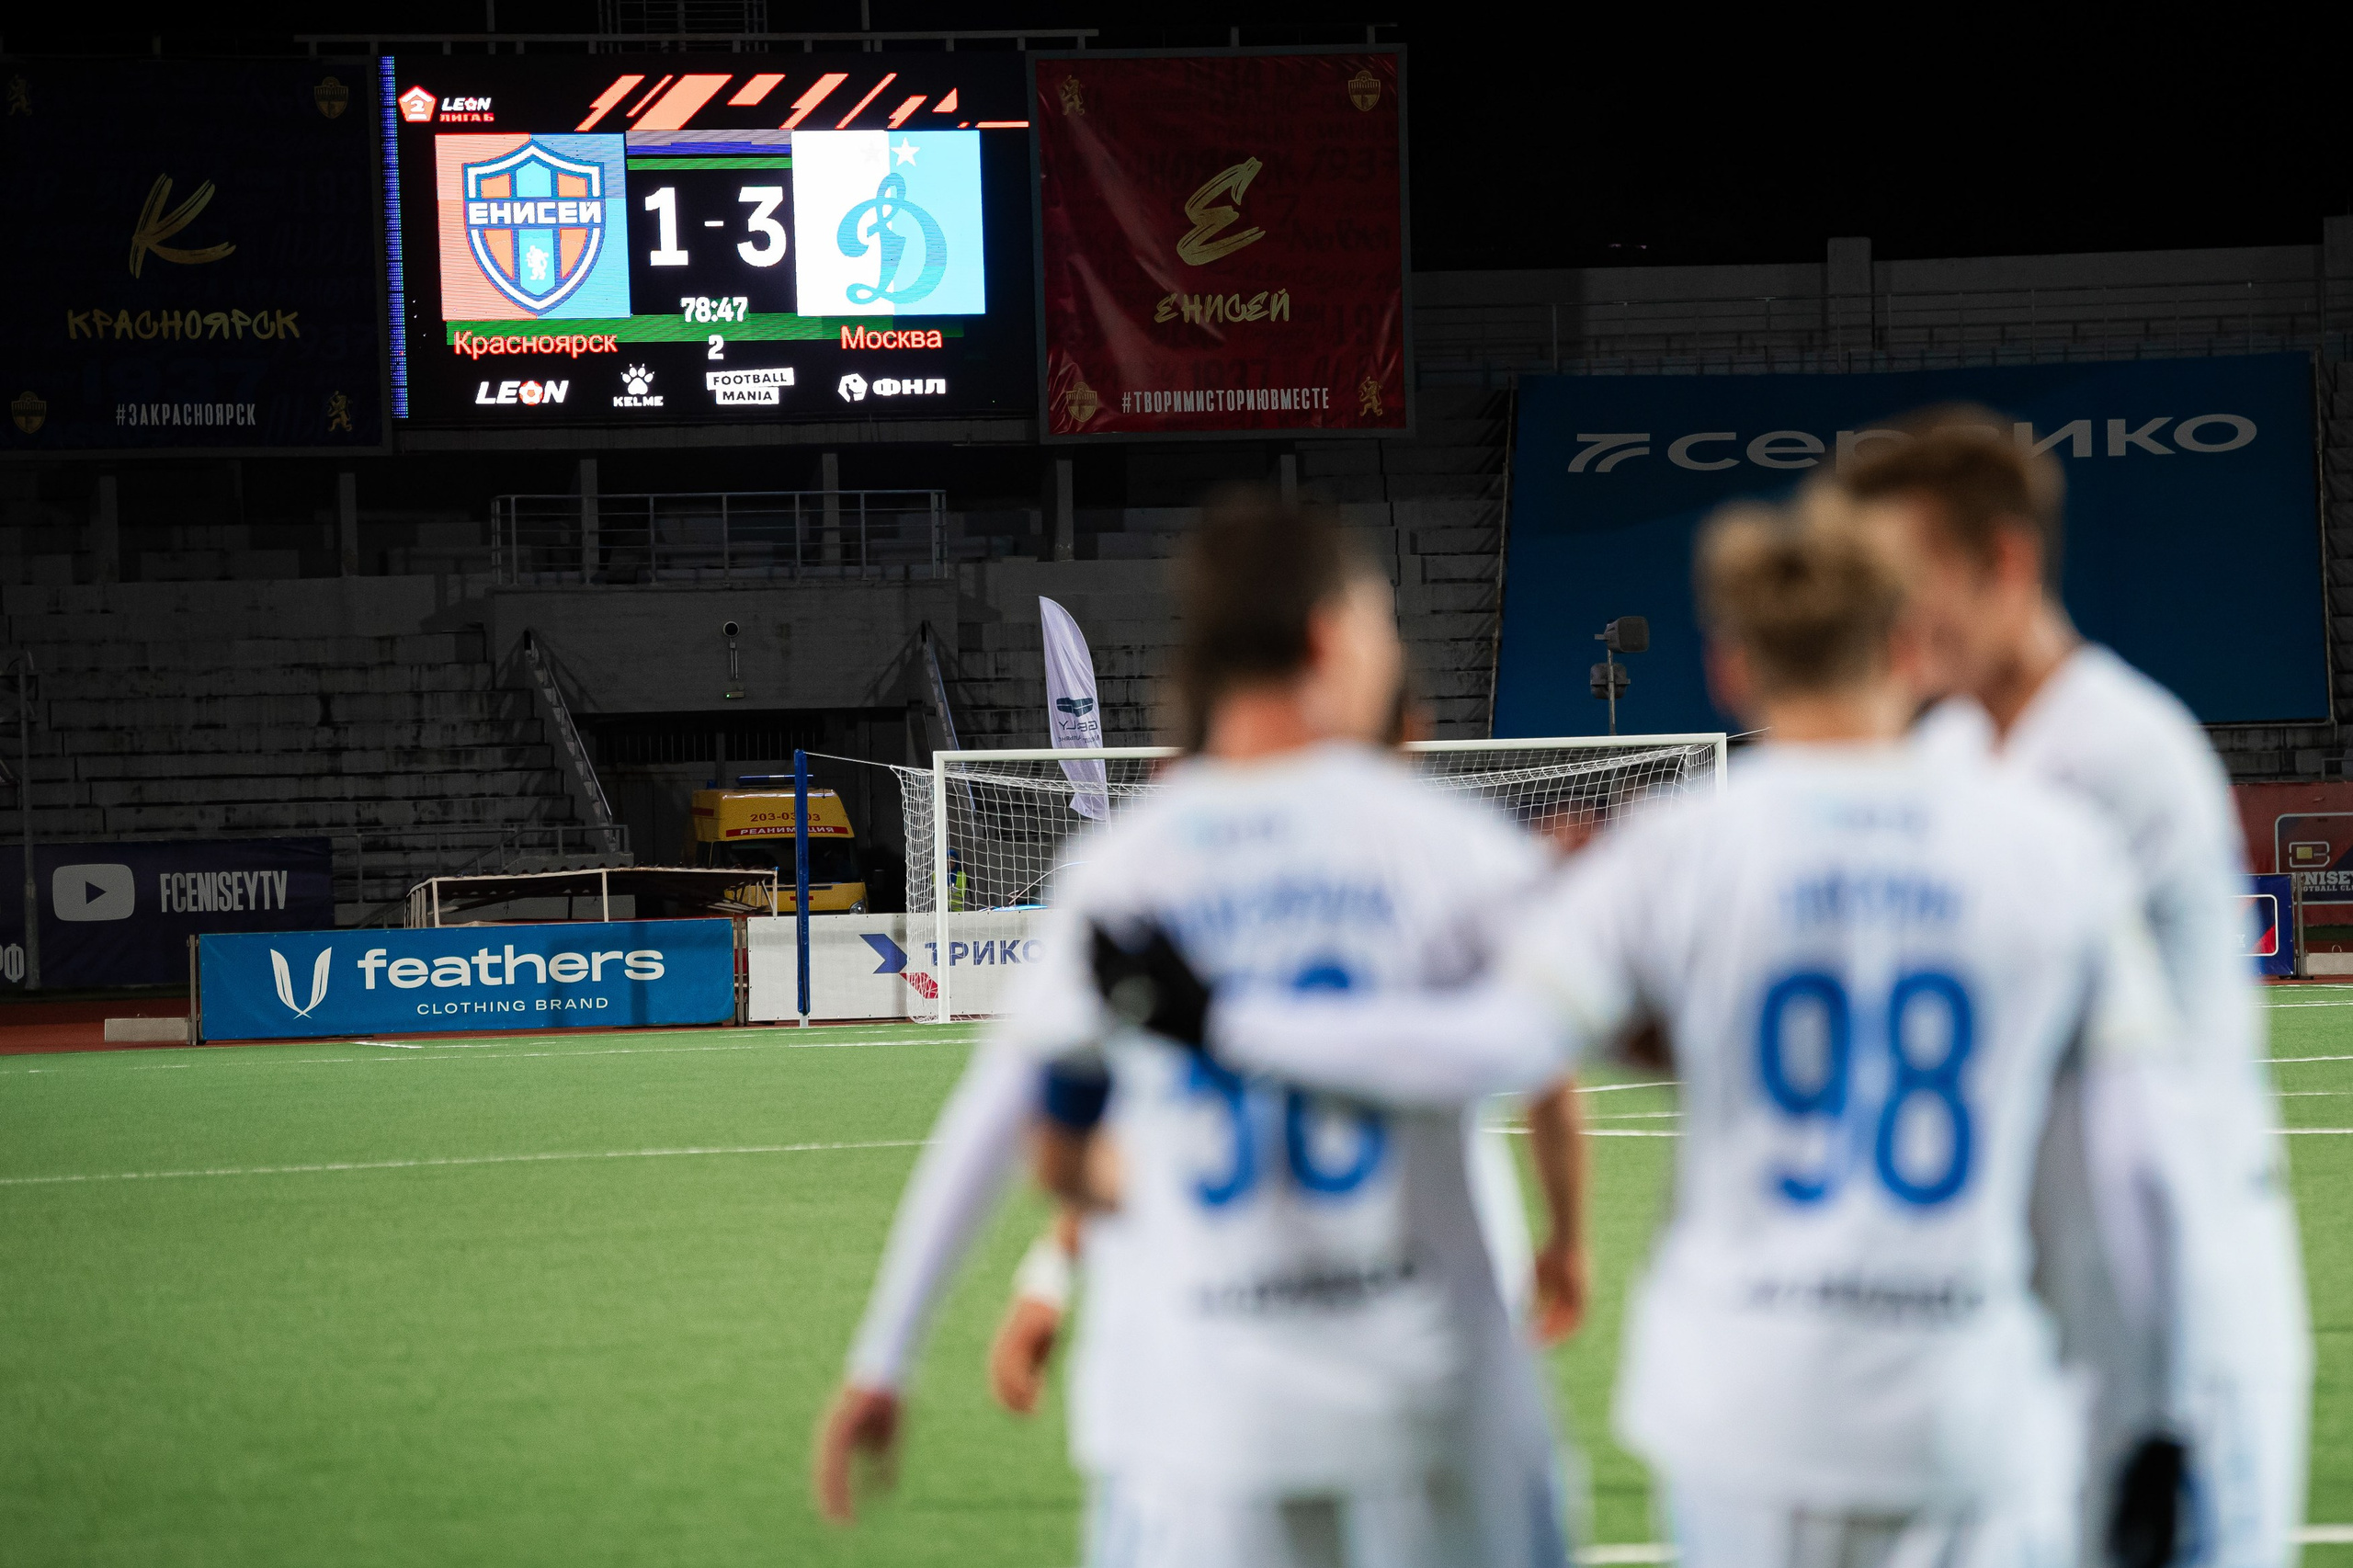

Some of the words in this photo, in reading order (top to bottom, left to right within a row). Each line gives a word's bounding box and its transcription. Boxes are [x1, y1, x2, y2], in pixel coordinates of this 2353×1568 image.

[468, 201, 601, 224] ЕНИСЕЙ
[644, 187, 688, 266] 1
[737, 186, 787, 267] 3
[681, 297, 747, 323] 78:47
[1154, 288, 1290, 324] ЕНИСЕЙ
[66, 308, 301, 340] КРАСНОЯРСК
[453, 331, 619, 359] Красноярск
[708, 335, 724, 359] 2
[840, 325, 942, 349] Москва
[712, 371, 787, 386] FOOTBALL
[872, 378, 947, 395] ФНЛ
[475, 380, 569, 405] LEON
[613, 395, 664, 407] KELME
[722, 390, 773, 402] MANIA
[1121, 388, 1330, 414] #ТВОРИМИСТОРИЮВМЕСТЕ
[116, 403, 256, 426] #ЗАКРАСНОЯРСК
[740, 827, 835, 835] РЕАНИМЦИЯ
[160, 870, 288, 913] FCENISEYTV
[358, 944, 665, 990] feathers
[416, 1000, 526, 1016] CLOTHING
[536, 996, 609, 1011] BRAND
[1759, 969, 1972, 1208] 98
